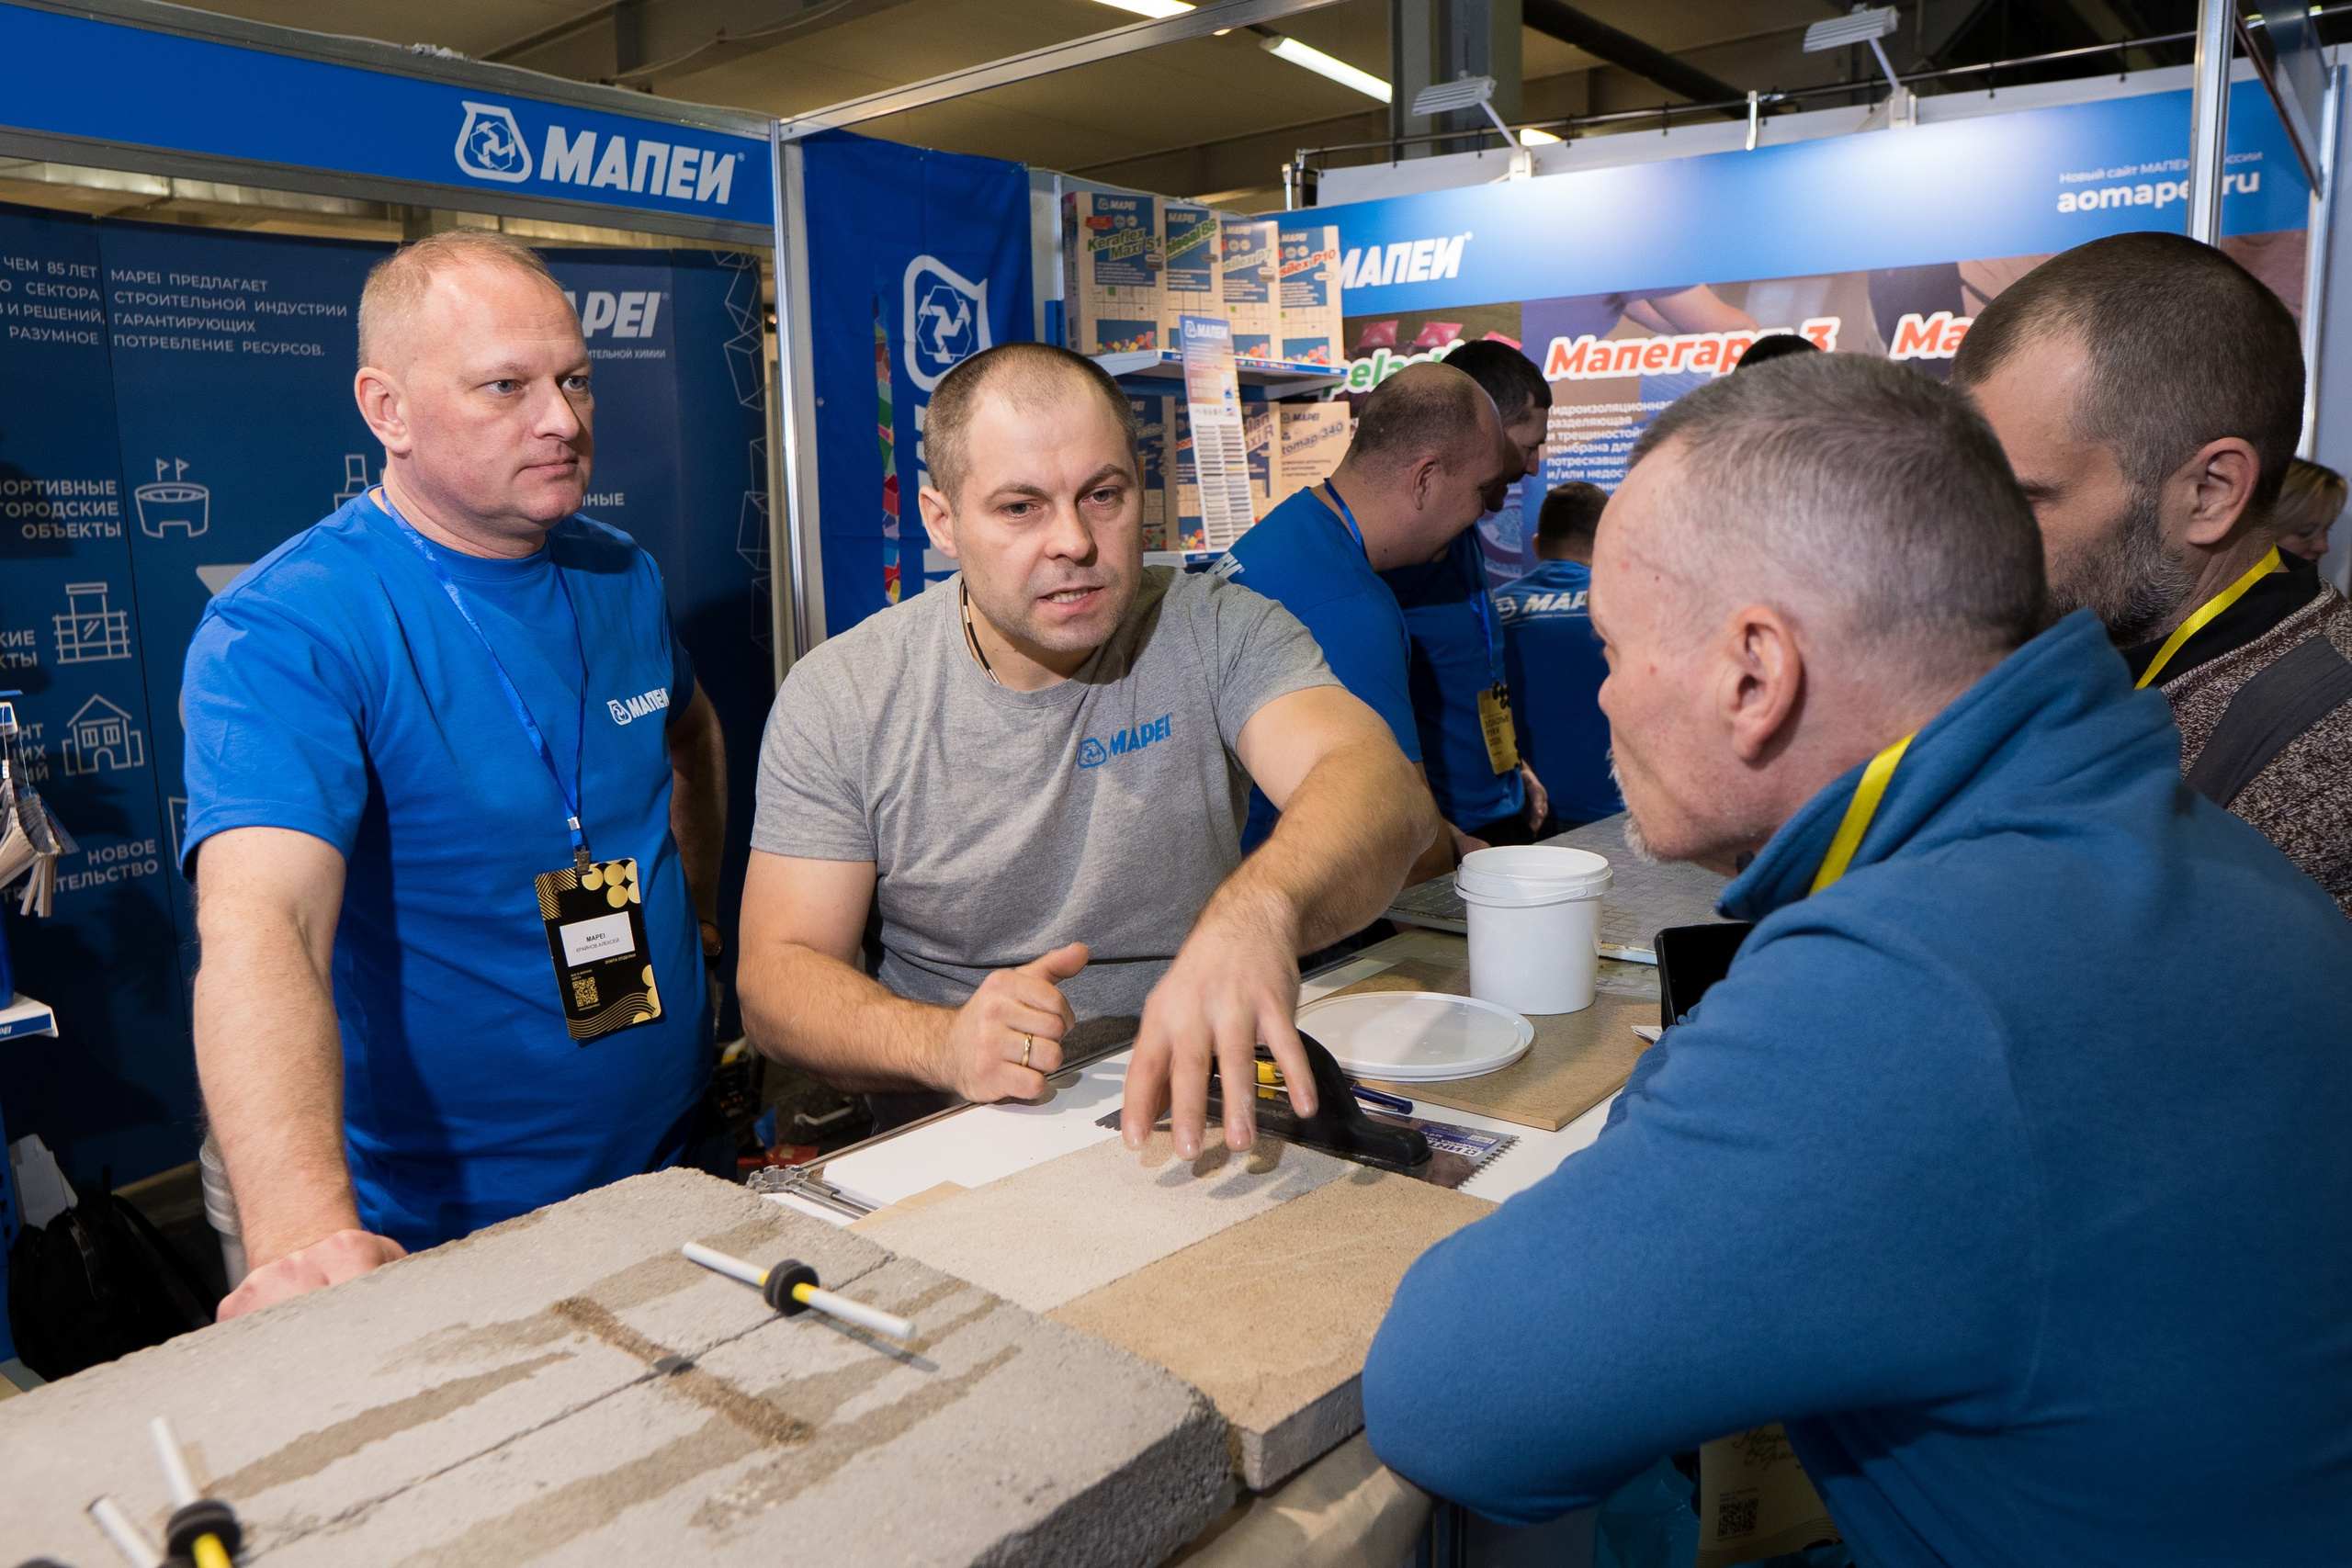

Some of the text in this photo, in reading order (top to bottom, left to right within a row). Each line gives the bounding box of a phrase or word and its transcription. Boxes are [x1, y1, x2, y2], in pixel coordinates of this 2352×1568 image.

[540, 125, 736, 204] МАПЕИ
[2059, 169, 2105, 185] Новый
[2107, 164, 2138, 179] сайт
[2056, 171, 2260, 213] aomaperu
[1087, 228, 1146, 252] Keraflex
[1110, 243, 1142, 260] Maxi
[3, 255, 97, 279] ЧЕМ 85 ЛЕТ
[1280, 260, 1310, 276] silex
[26, 281, 100, 301] СЕКТОРА
[169, 274, 268, 292] ПРЕДЛАГАЕТ
[24, 304, 106, 325] РЕШЕНИЙ,
[114, 291, 348, 318] СТРОИТЕЛЬНОЙ ИНДУСТРИИ
[565, 291, 662, 338] PEI
[114, 313, 256, 333] ГАРАНТИРУЮЩИХ
[9, 325, 99, 345] РАЗУМНОЕ
[114, 335, 234, 353] ПОТРЕБЛЕНИЕ
[1549, 336, 1753, 375] Мапегар
[0, 479, 118, 497] ОРТИВНЫЕ
[22, 524, 121, 540] ОБЪЕКТЫ
[1109, 713, 1171, 757] MAPEI
[87, 839, 157, 866] НОВОЕ
[586, 932, 606, 942] MAPEI
[598, 938, 620, 948] АЛЕКСЕЙ
